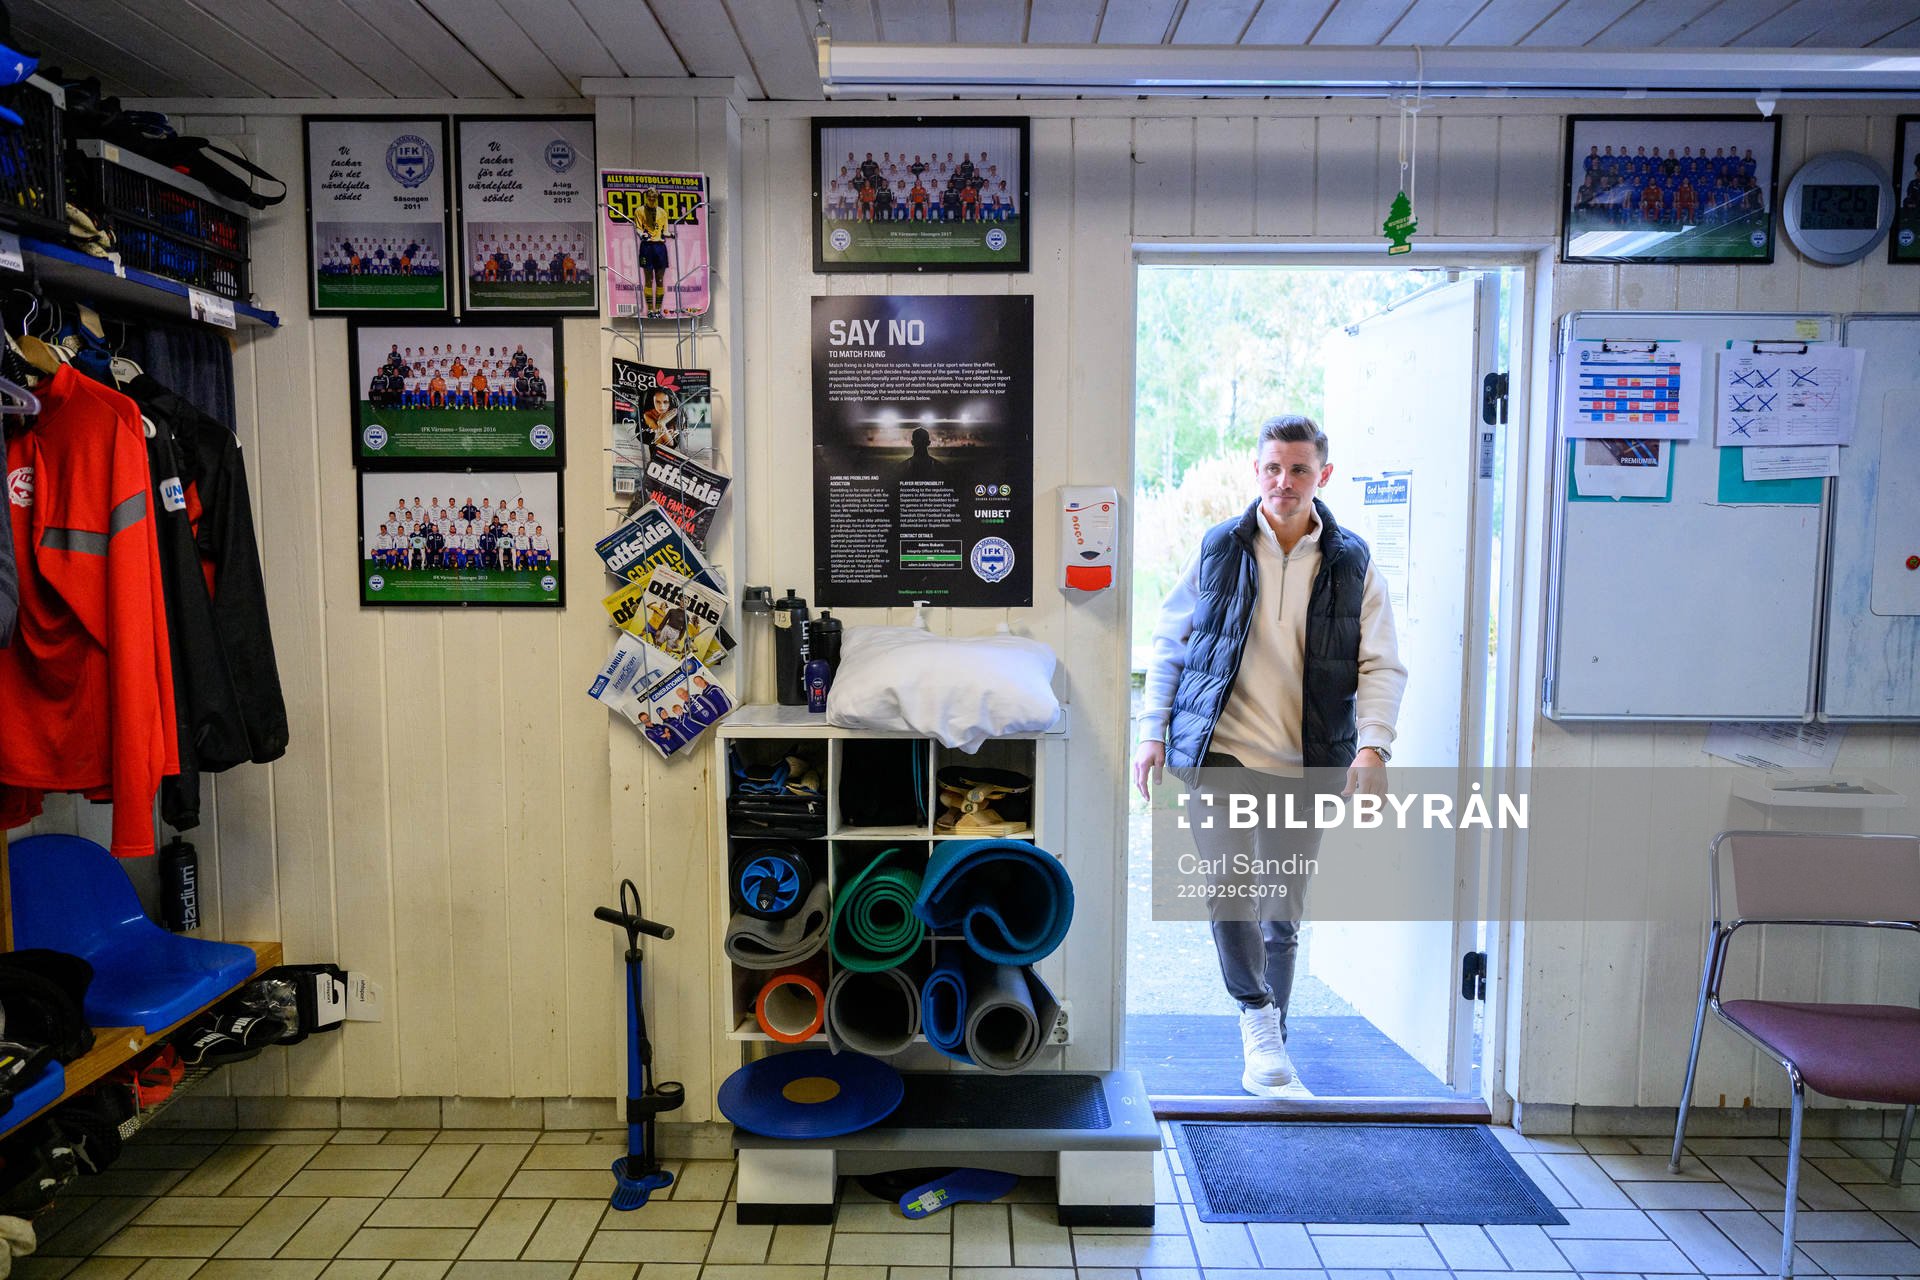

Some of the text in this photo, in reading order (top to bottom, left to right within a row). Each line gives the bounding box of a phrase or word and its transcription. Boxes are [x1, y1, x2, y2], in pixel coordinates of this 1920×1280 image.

[338, 146, 350, 155] Vi
[400, 147, 419, 155] IFK
[488, 142, 502, 152] Vi
[331, 158, 362, 166] tackar
[480, 154, 514, 164] tackar
[329, 170, 362, 180] för det
[478, 168, 514, 180] för det
[322, 181, 370, 192] värdefulla
[468, 180, 523, 192] värdefulla
[682, 177, 698, 186] 1994
[334, 192, 362, 200] stödet
[482, 194, 514, 202] stödet
[607, 191, 698, 220] SPRT
[829, 319, 925, 346] SAY NO
[614, 362, 658, 390] Yoga
[647, 462, 721, 506] offside
[165, 484, 183, 498] UN
[974, 510, 1011, 518] UNIBET
[606, 521, 672, 572] offside
[627, 544, 681, 581] GRATTIS
[606, 650, 627, 676] MANUAL
[651, 674, 686, 701] GENERATIONER
[181, 864, 197, 930] stadium
